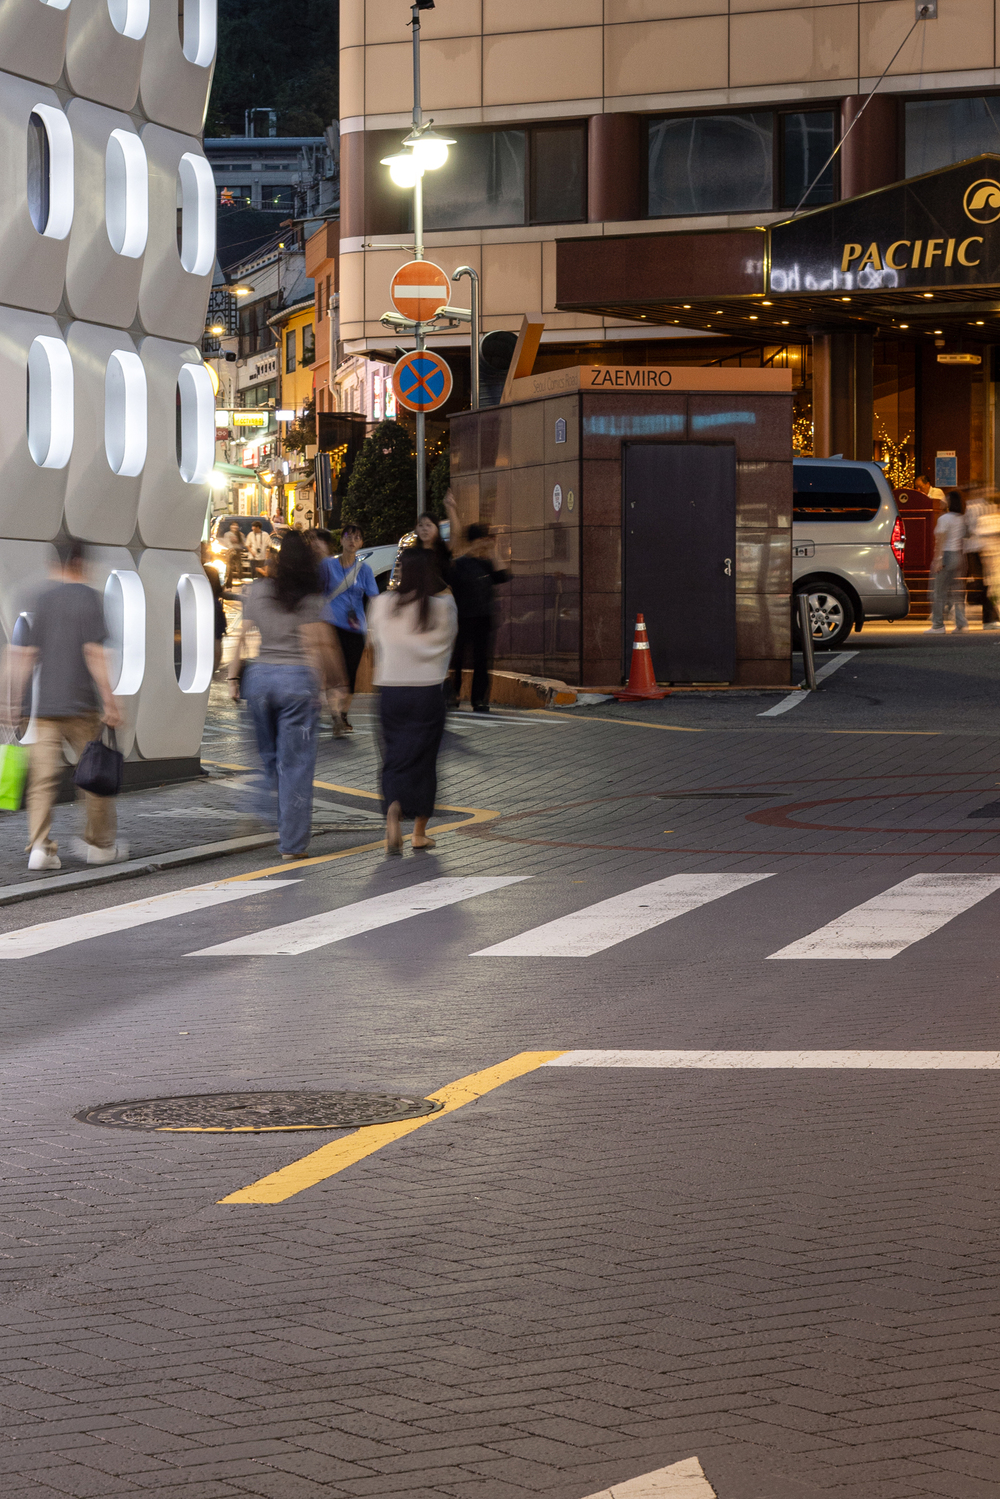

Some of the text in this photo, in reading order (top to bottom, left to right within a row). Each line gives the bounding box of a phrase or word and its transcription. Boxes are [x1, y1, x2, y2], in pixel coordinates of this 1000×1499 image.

[840, 236, 984, 272] PACIFIC
[533, 378, 546, 393] Seoul
[565, 372, 579, 387] Road
[591, 369, 672, 387] ZAEMIRO
